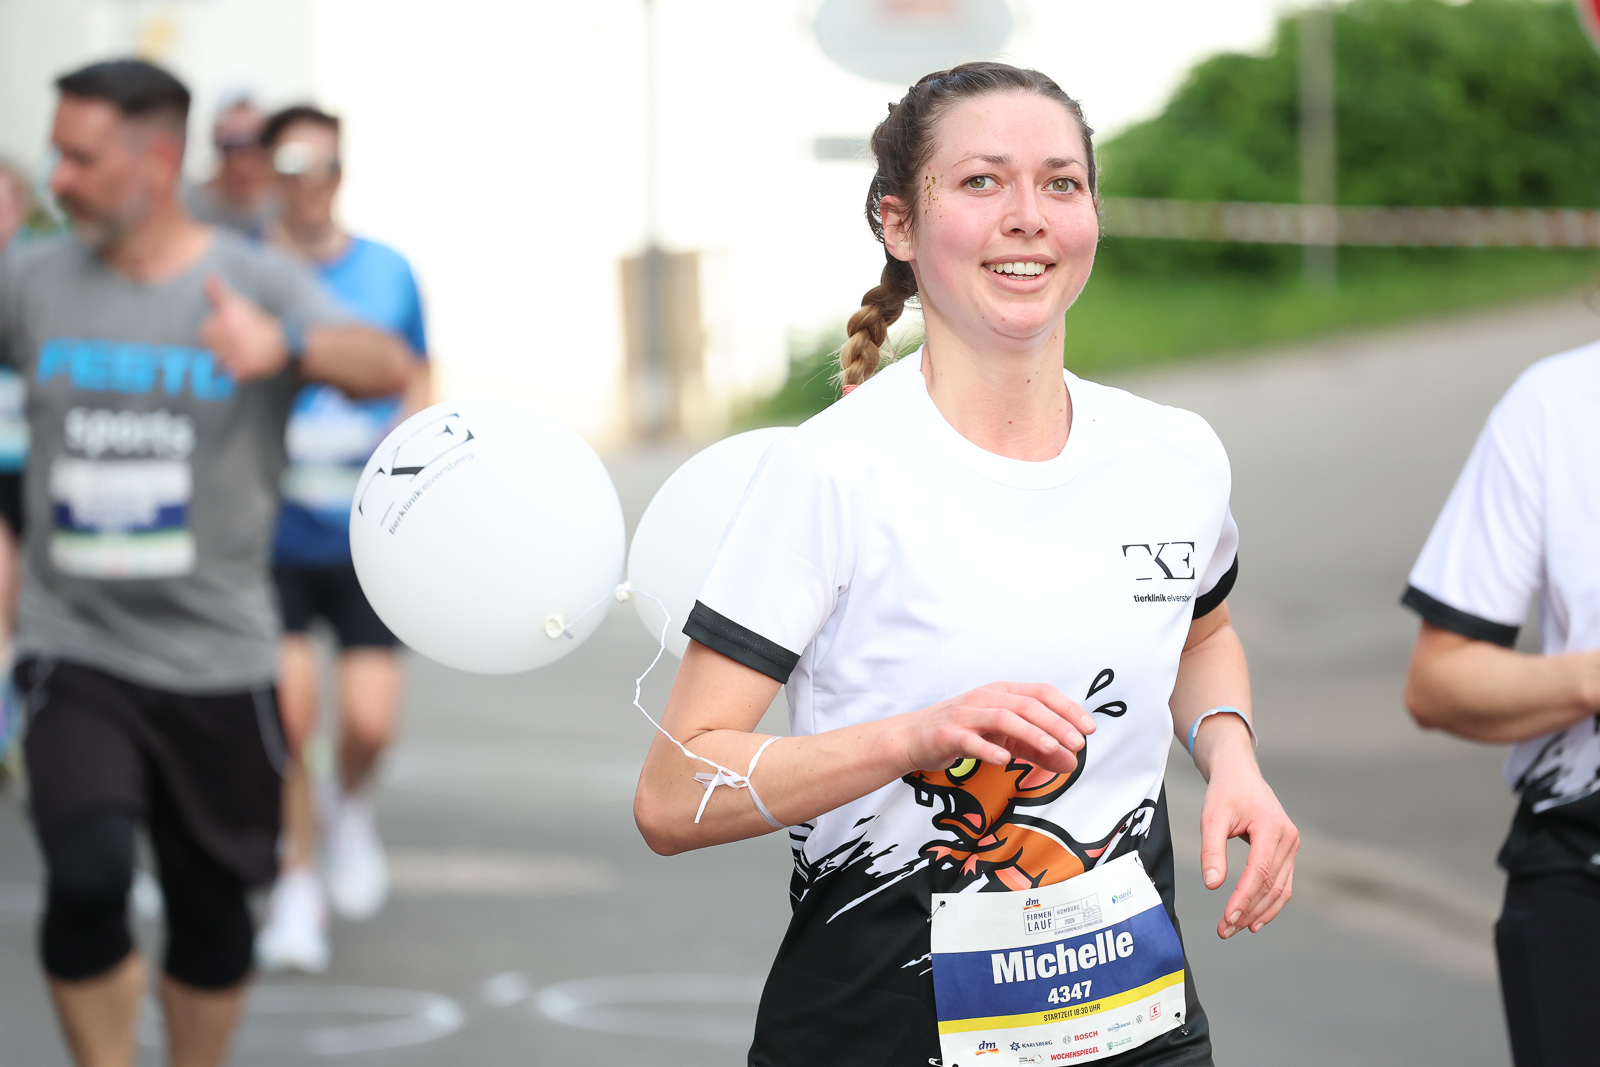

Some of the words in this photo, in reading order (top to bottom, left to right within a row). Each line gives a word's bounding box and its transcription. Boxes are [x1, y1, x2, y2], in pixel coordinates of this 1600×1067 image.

[389, 489, 423, 535] tierklinik
[1121, 541, 1195, 581] TKE
[1133, 593, 1167, 603] tierklinik
[1026, 910, 1052, 921] FIRMEN
[1056, 904, 1081, 915] HOMBURG
[1027, 918, 1053, 932] LAUF
[990, 928, 1135, 985] Michelle
[1047, 979, 1093, 1005] 4347
[1043, 1009, 1073, 1022] STARTZEIT
[1073, 1006, 1089, 1016] 18:30
[1088, 1003, 1101, 1013] UHR
[1074, 1030, 1099, 1042] BOSCH
[1021, 1039, 1053, 1049] KARLSBERG
[1050, 1046, 1099, 1061] WOCHENSPIEGEL
